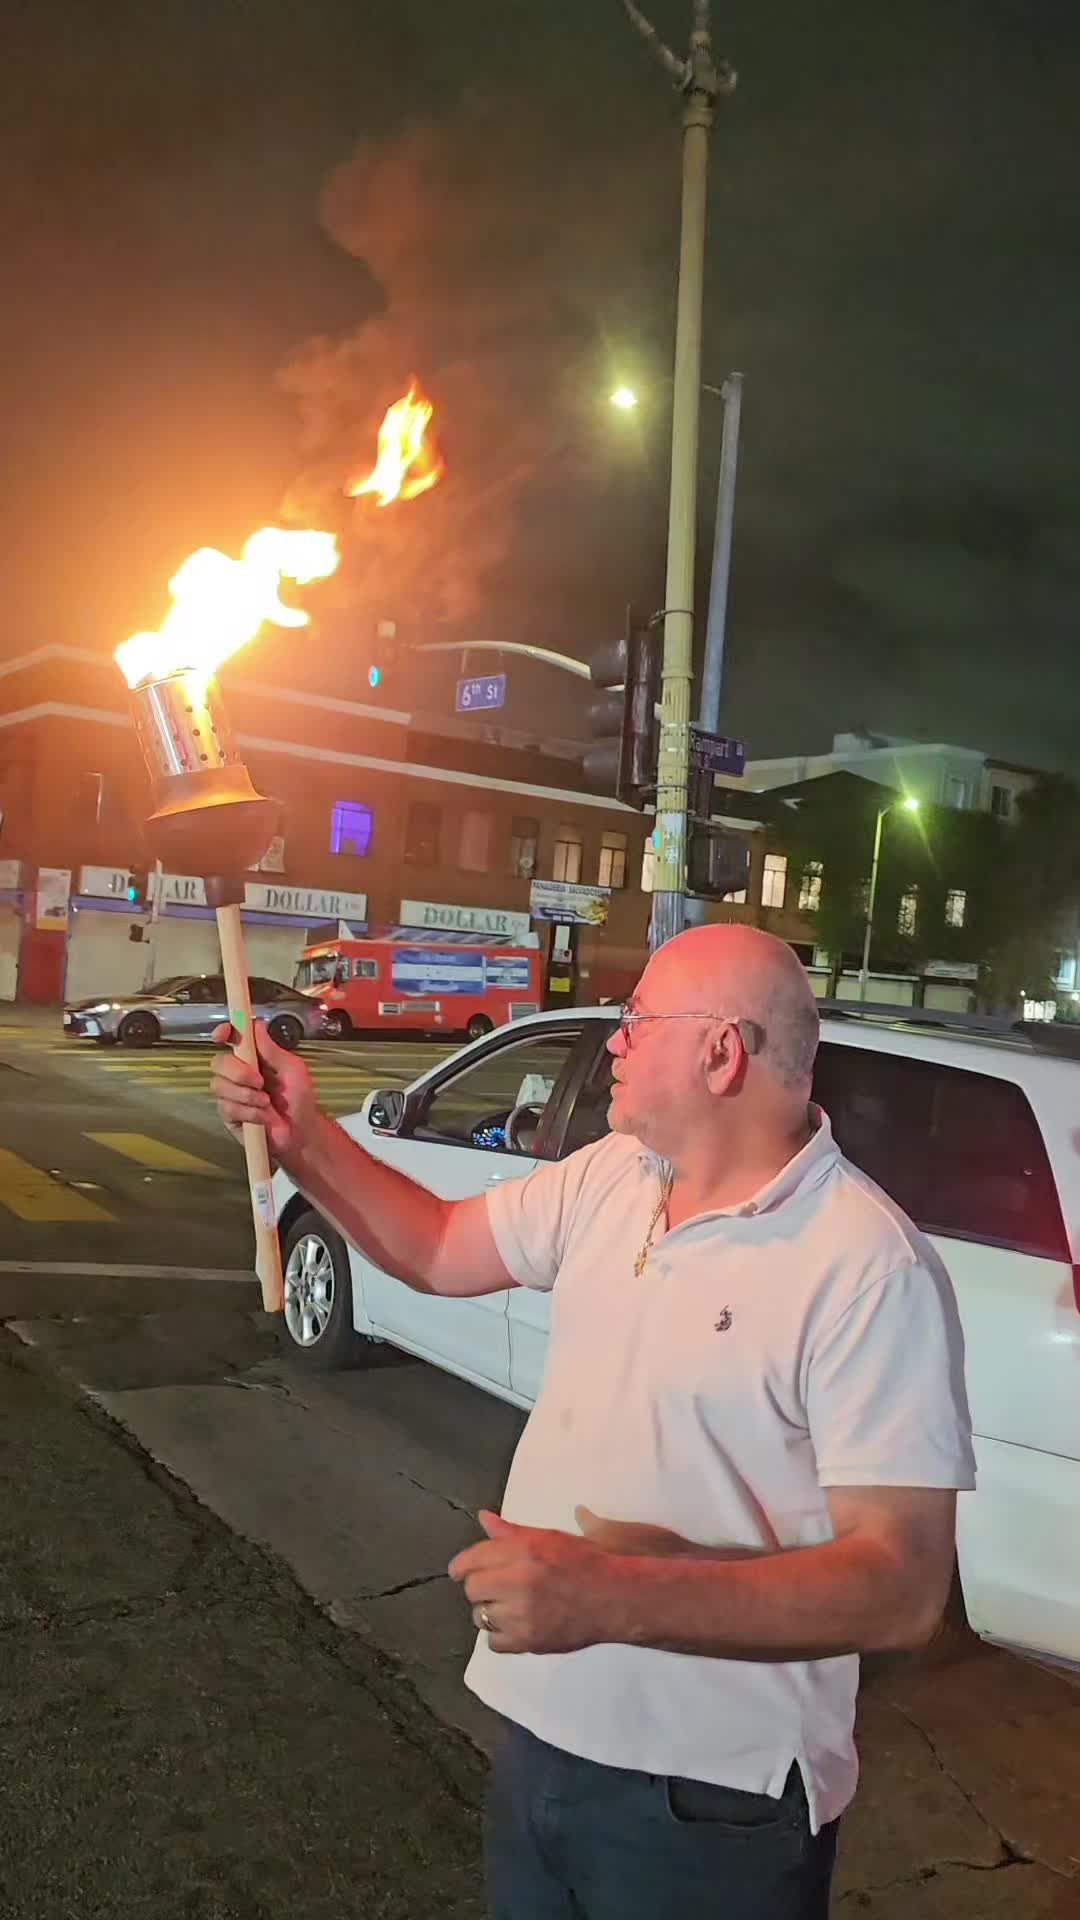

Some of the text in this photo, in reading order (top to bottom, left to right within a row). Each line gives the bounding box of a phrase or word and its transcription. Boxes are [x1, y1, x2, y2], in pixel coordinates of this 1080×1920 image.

[462, 683, 498, 706] 6th St
[265, 888, 341, 914] DOLLAR
[424, 906, 508, 932] DOLLAR
